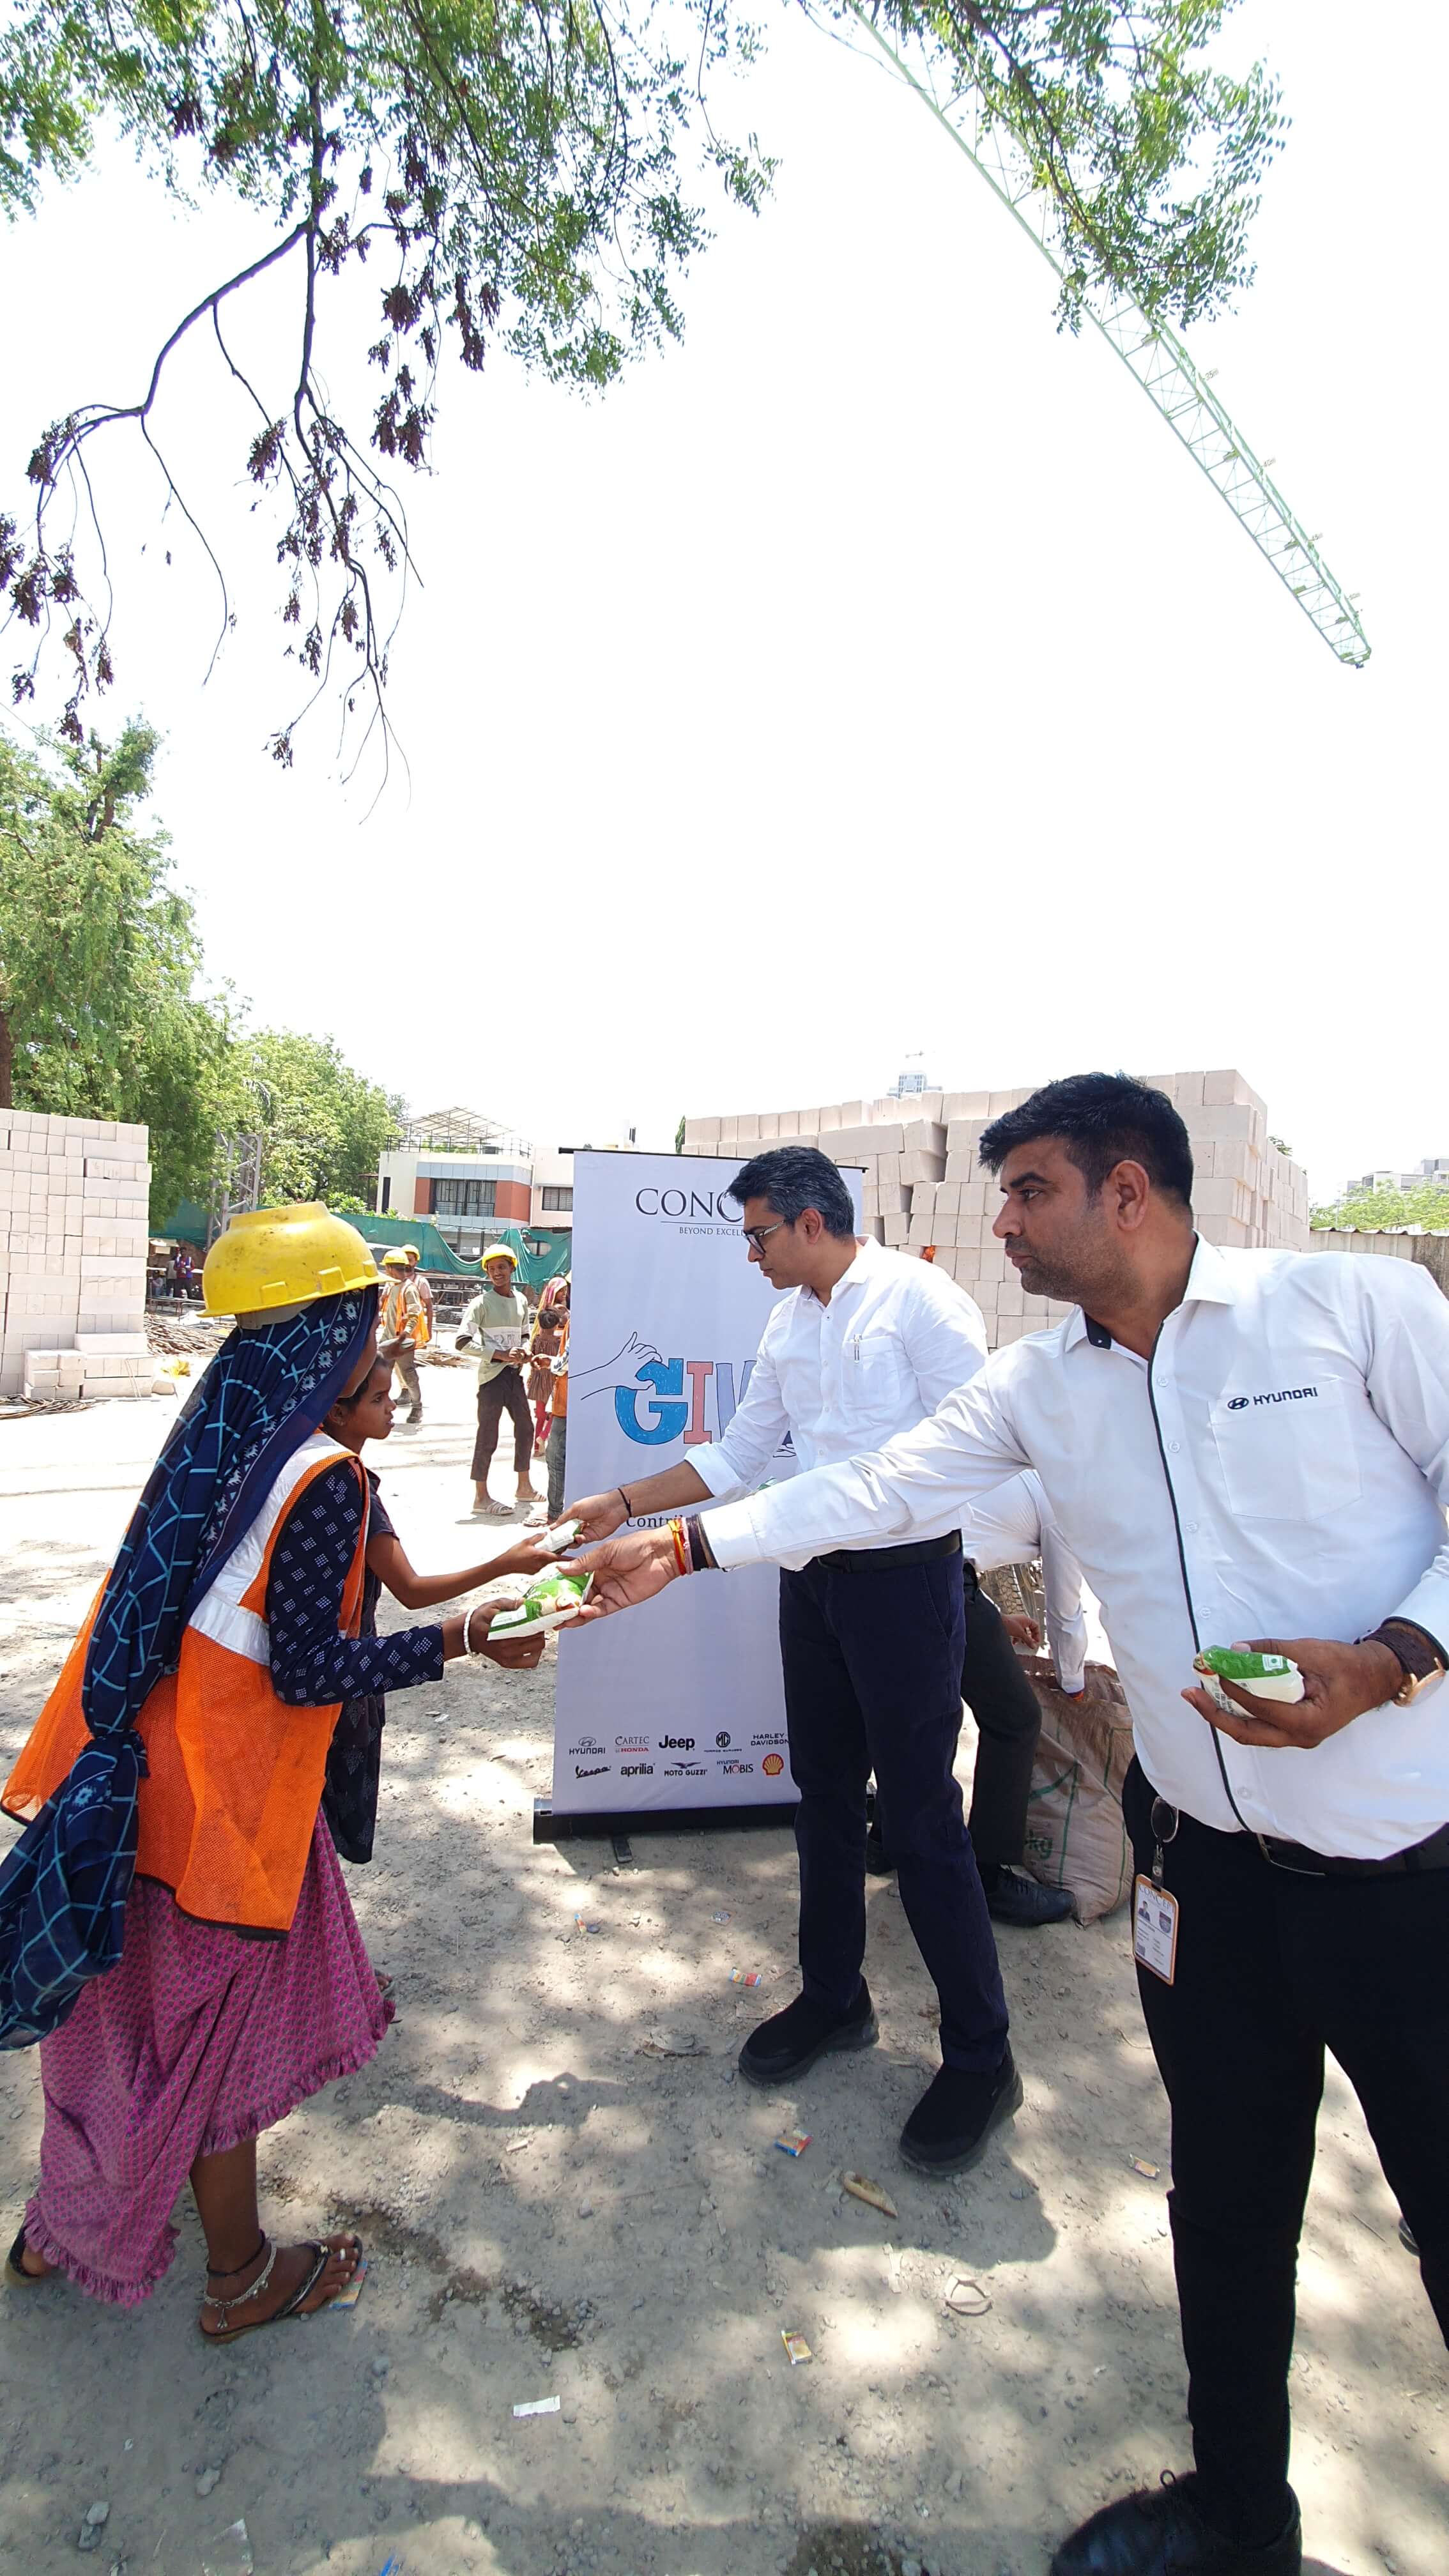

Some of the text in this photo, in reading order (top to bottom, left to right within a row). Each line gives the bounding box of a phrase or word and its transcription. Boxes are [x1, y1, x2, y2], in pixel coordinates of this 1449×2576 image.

[679, 1227, 714, 1235] BEYOND
[1253, 1386, 1319, 1406] HYUNDAI
[615, 1735, 650, 1745] CARTEC
[659, 1735, 695, 1751] Jeep
[717, 1732, 730, 1747] MG
[569, 1747, 606, 1755] HYUNDAI
[620, 1763, 654, 1777] aprilia
[723, 1764, 754, 1774] MOBIS
